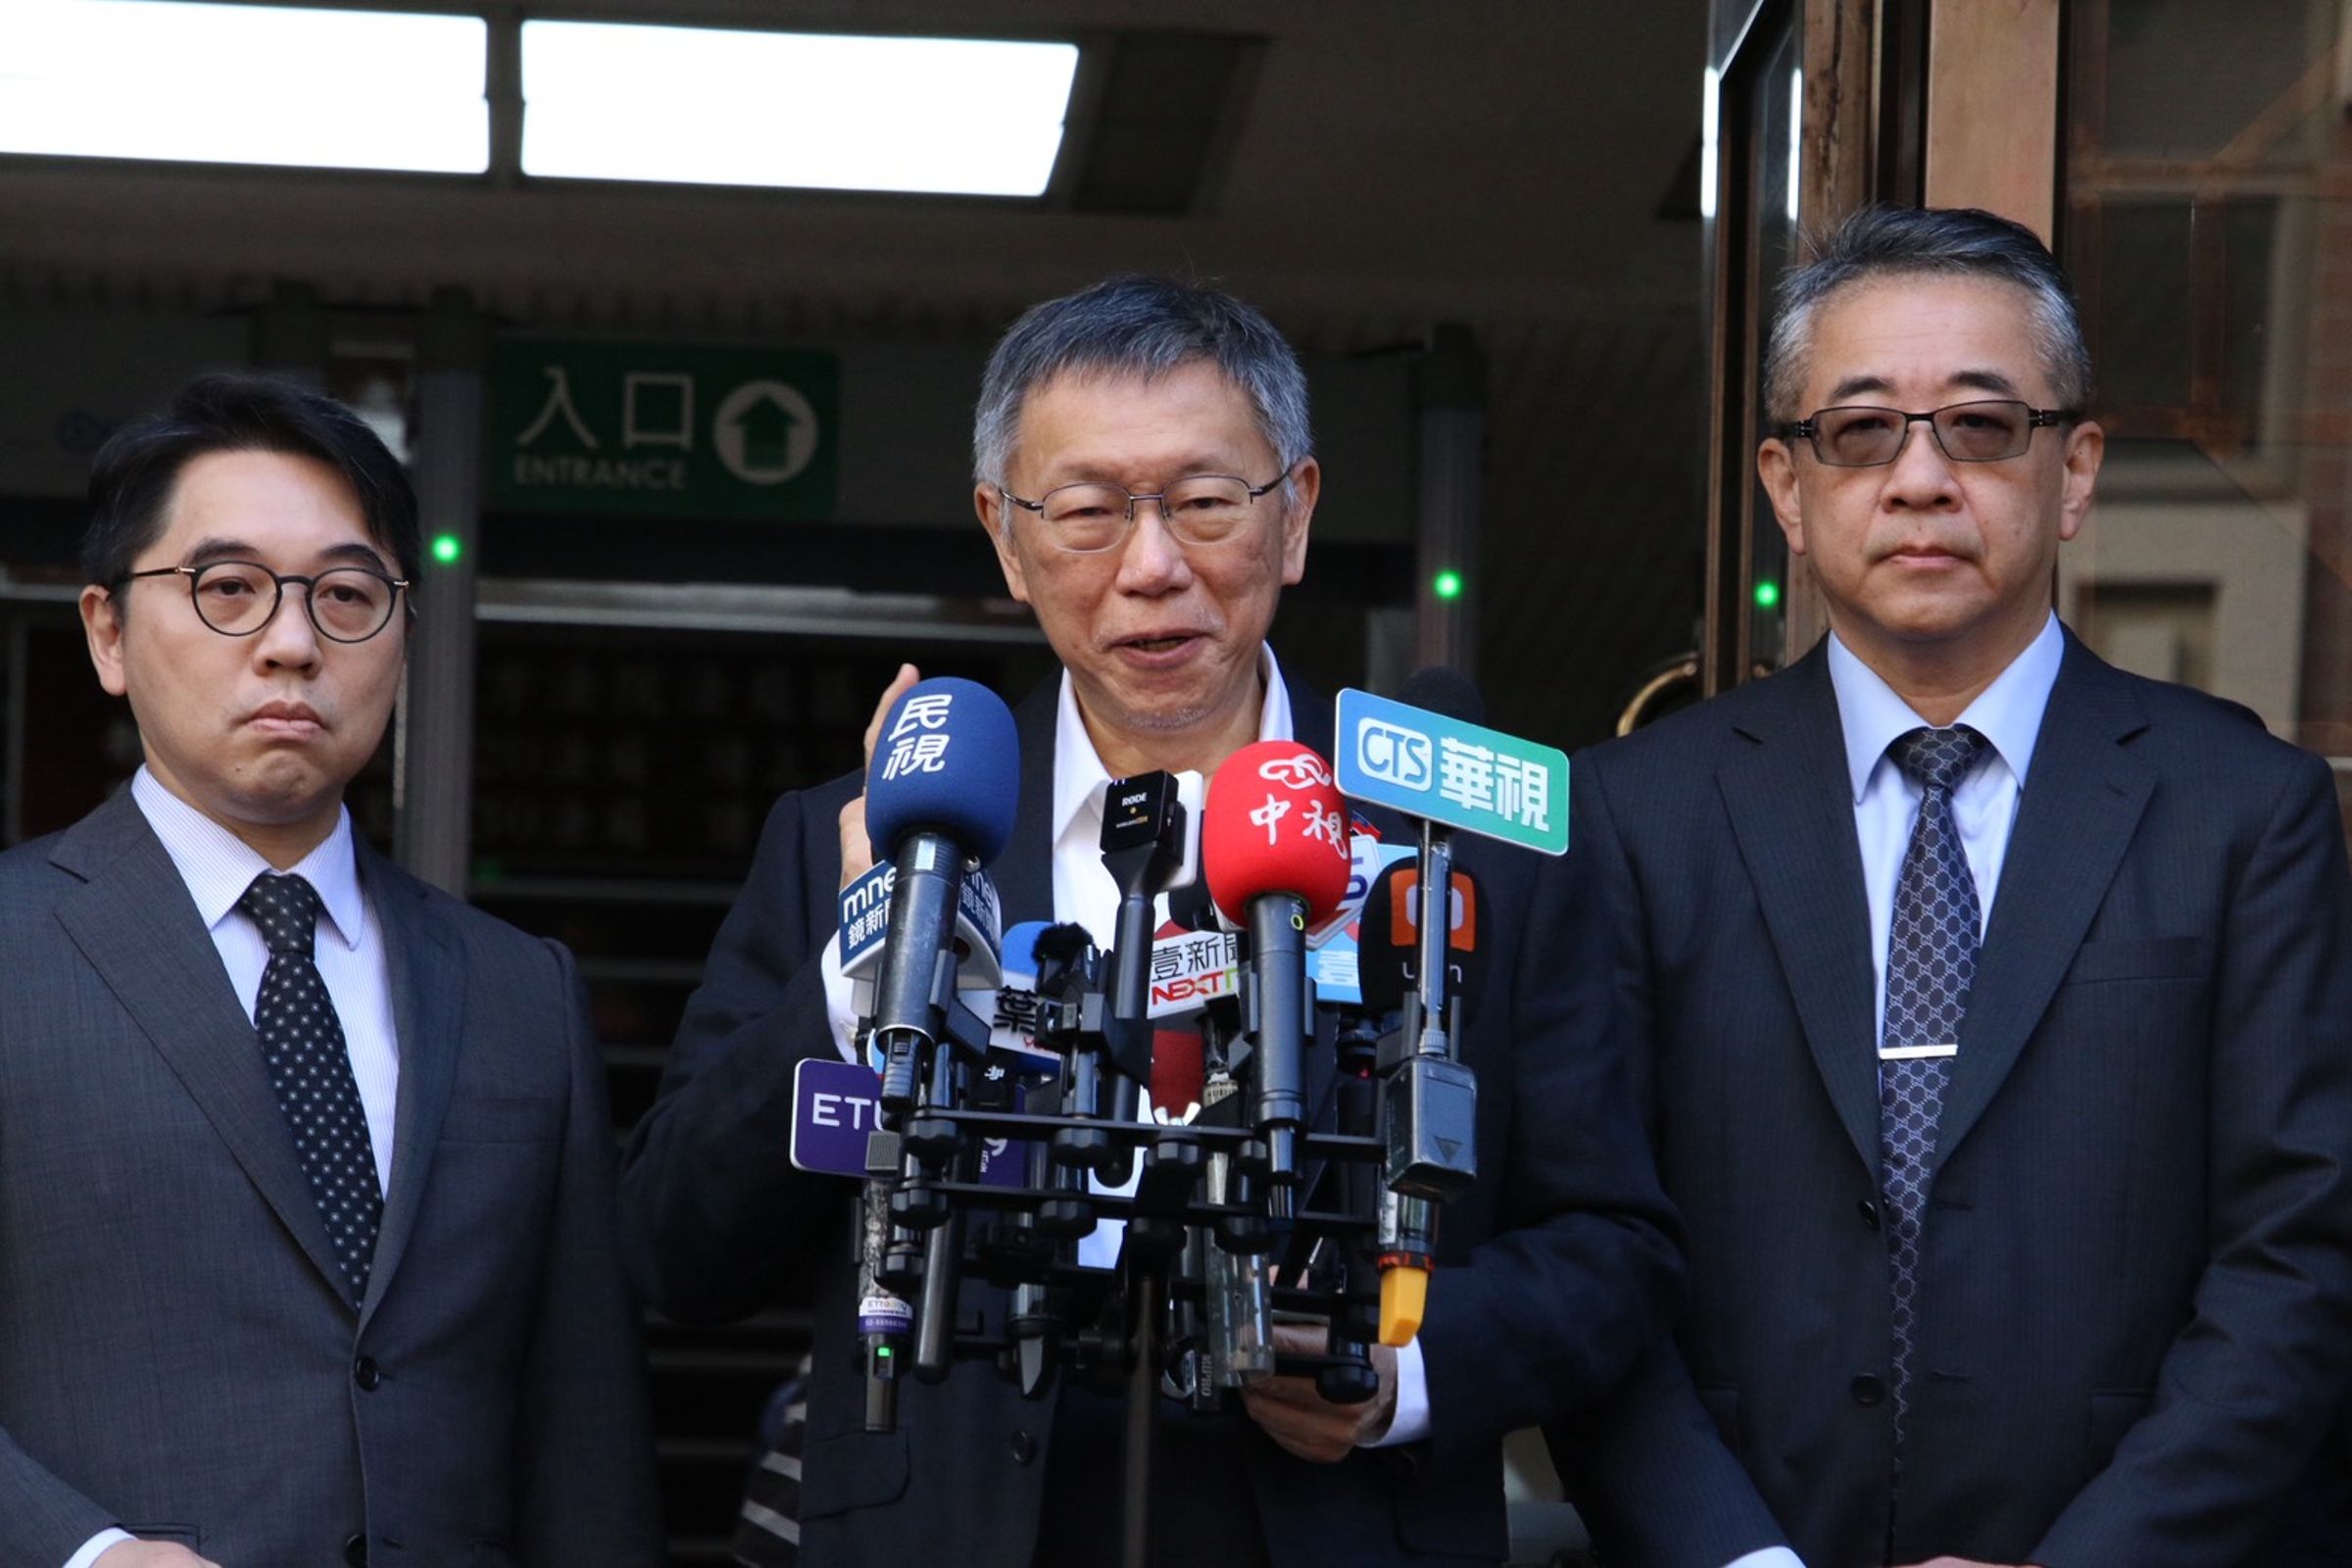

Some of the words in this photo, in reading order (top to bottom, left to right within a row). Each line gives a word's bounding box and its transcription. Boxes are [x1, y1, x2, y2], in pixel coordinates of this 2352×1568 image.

[516, 365, 694, 451] 入口
[514, 456, 687, 490] ENTRANCE
[883, 694, 953, 780] 民視
[1361, 726, 1427, 785] CTS
[1439, 736, 1550, 833] 華視
[1249, 794, 1348, 859] 中視
[848, 899, 891, 950] 鏡新
[1402, 961, 1462, 983] un
